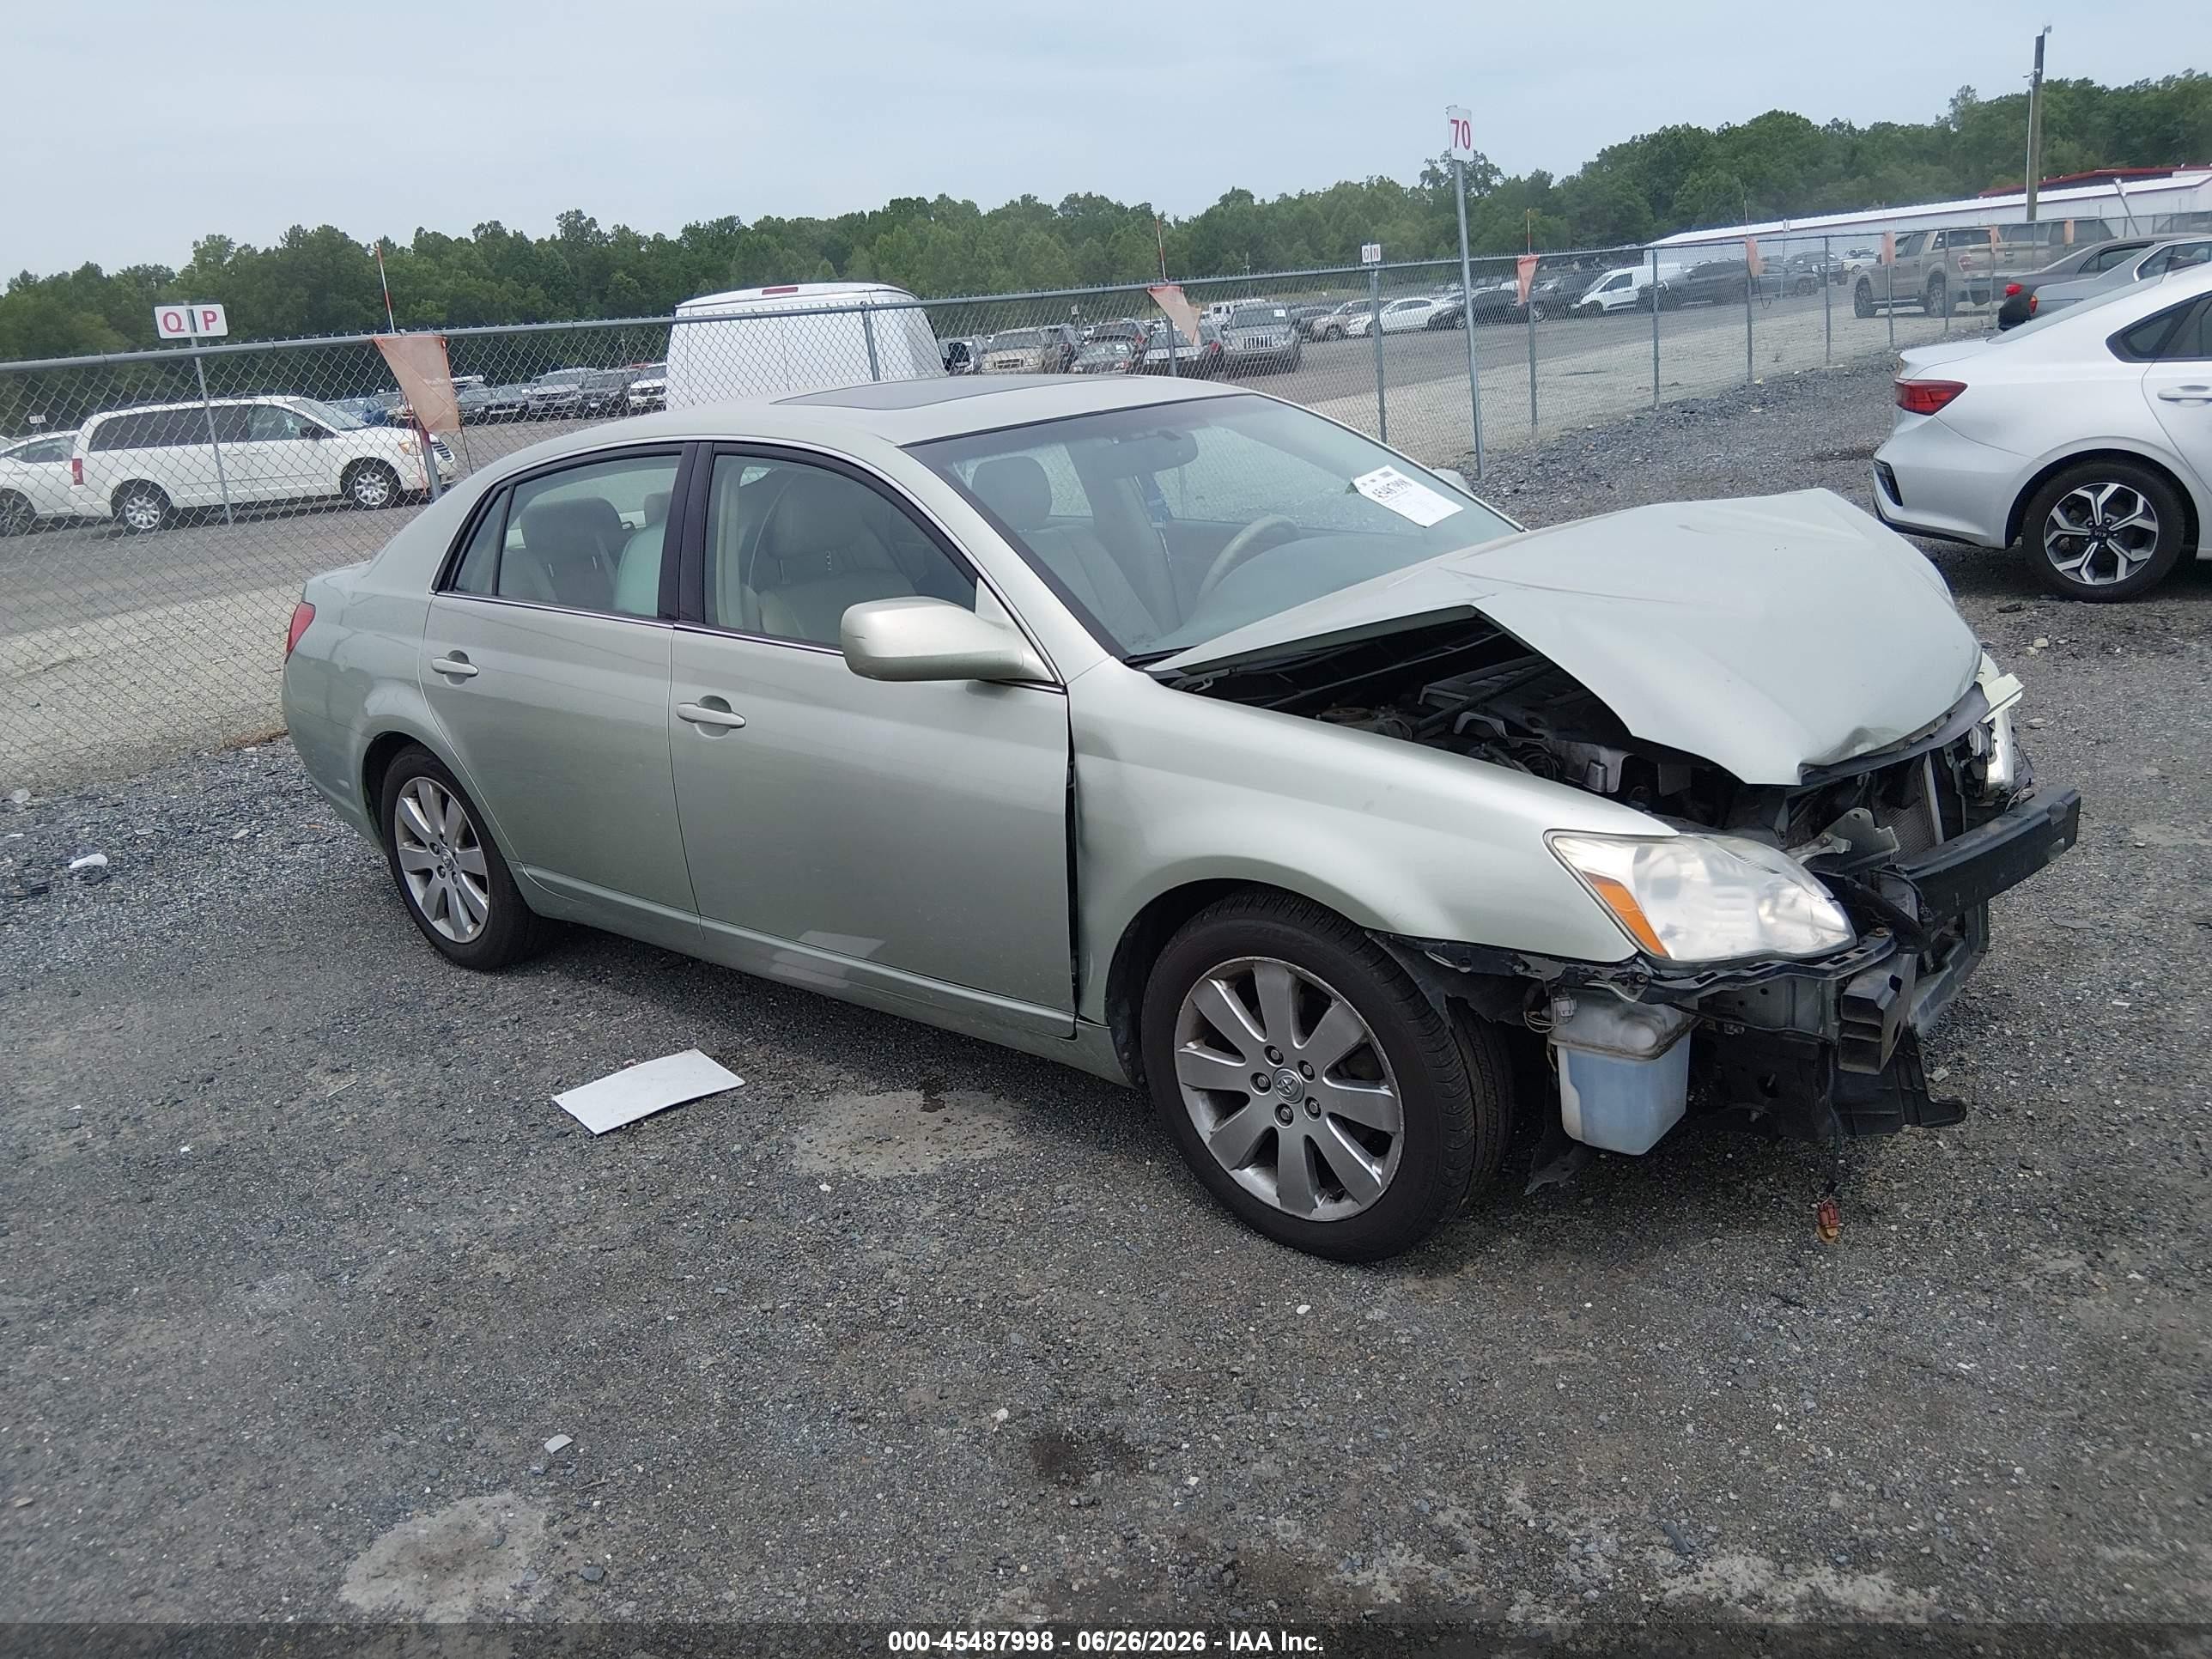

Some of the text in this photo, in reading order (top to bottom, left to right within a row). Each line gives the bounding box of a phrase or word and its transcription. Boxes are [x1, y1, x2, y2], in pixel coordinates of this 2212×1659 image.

[1449, 118, 1471, 150] 70
[162, 310, 218, 333] Q P
